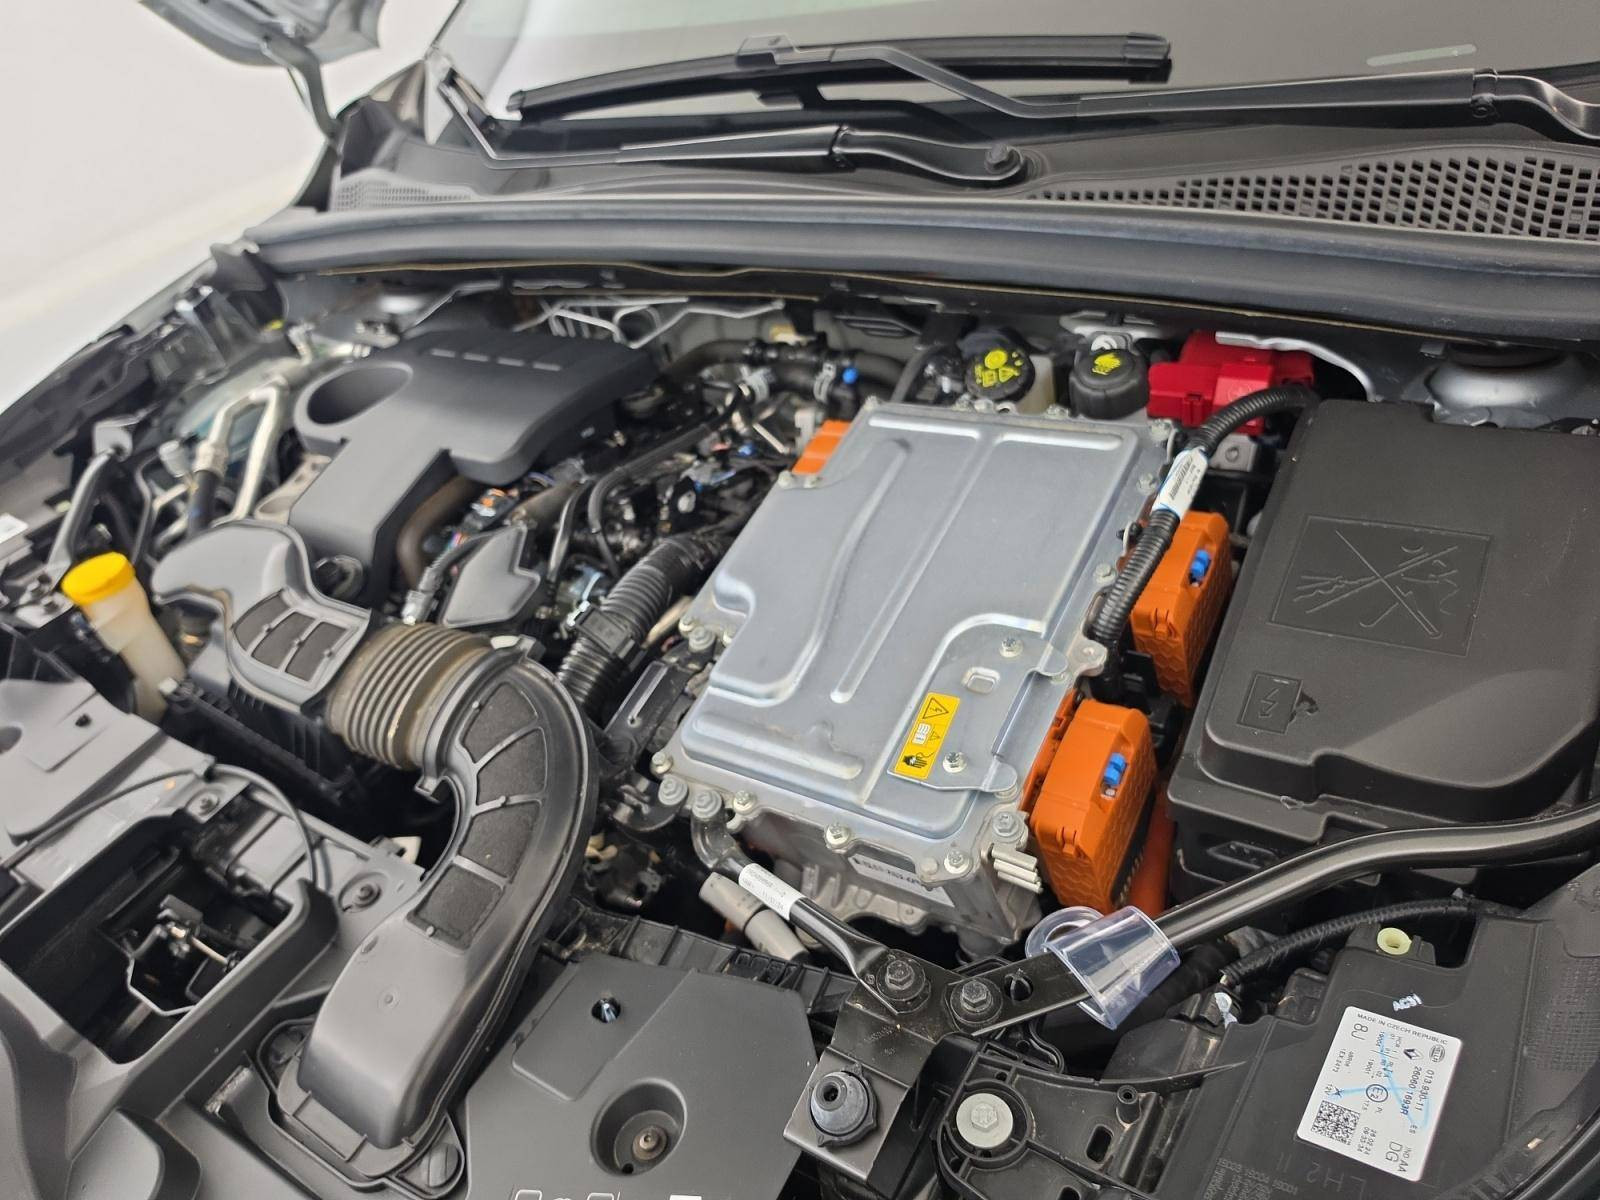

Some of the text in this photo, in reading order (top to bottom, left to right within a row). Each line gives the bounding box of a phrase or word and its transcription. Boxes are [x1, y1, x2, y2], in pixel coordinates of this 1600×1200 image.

[1349, 1022, 1369, 1040] 8J
[1356, 1013, 1377, 1023] MADE
[1386, 1023, 1411, 1033] CZECH
[1411, 1030, 1447, 1044] REPUBLIC
[1399, 1065, 1422, 1115] 26060 1693R
[1383, 1140, 1403, 1164] DG
[1396, 1159, 1409, 1173] AA
